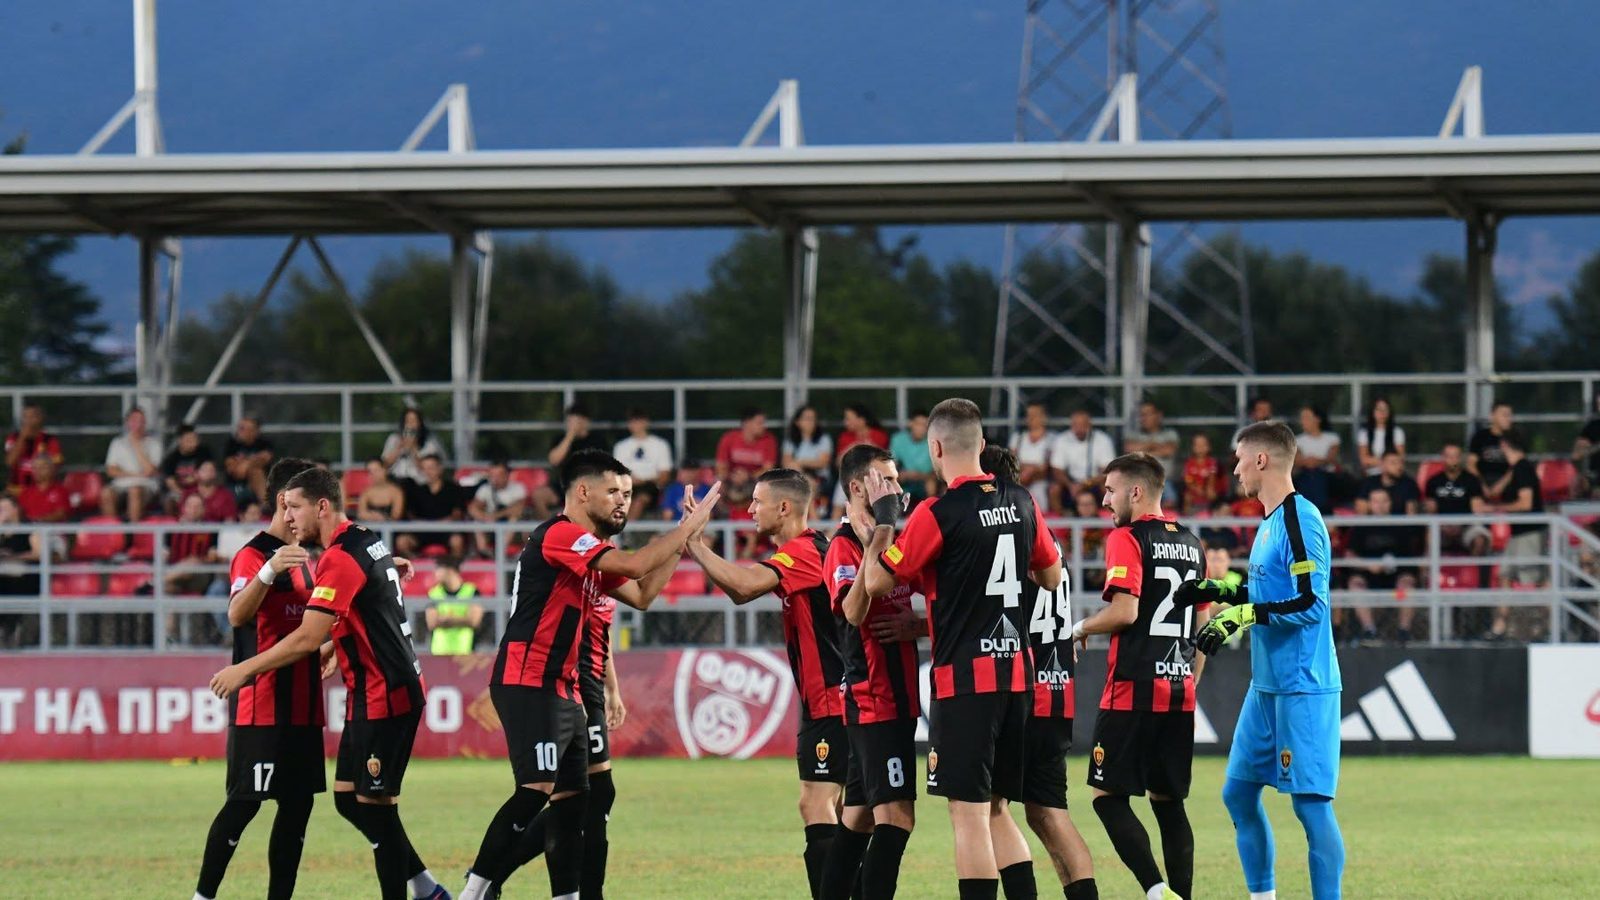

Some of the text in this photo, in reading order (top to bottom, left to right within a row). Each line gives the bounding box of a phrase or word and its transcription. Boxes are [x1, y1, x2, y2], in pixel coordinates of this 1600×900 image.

[978, 503, 1021, 527] MATIĆ
[985, 533, 1022, 608] 4
[1029, 567, 1073, 644] 49
[1149, 566, 1197, 639] 21
[34, 687, 108, 734] НА
[118, 687, 228, 734] ПРВ
[587, 725, 604, 754] 5
[535, 742, 557, 771] 10
[252, 762, 275, 792] 17
[887, 757, 904, 788] 8
